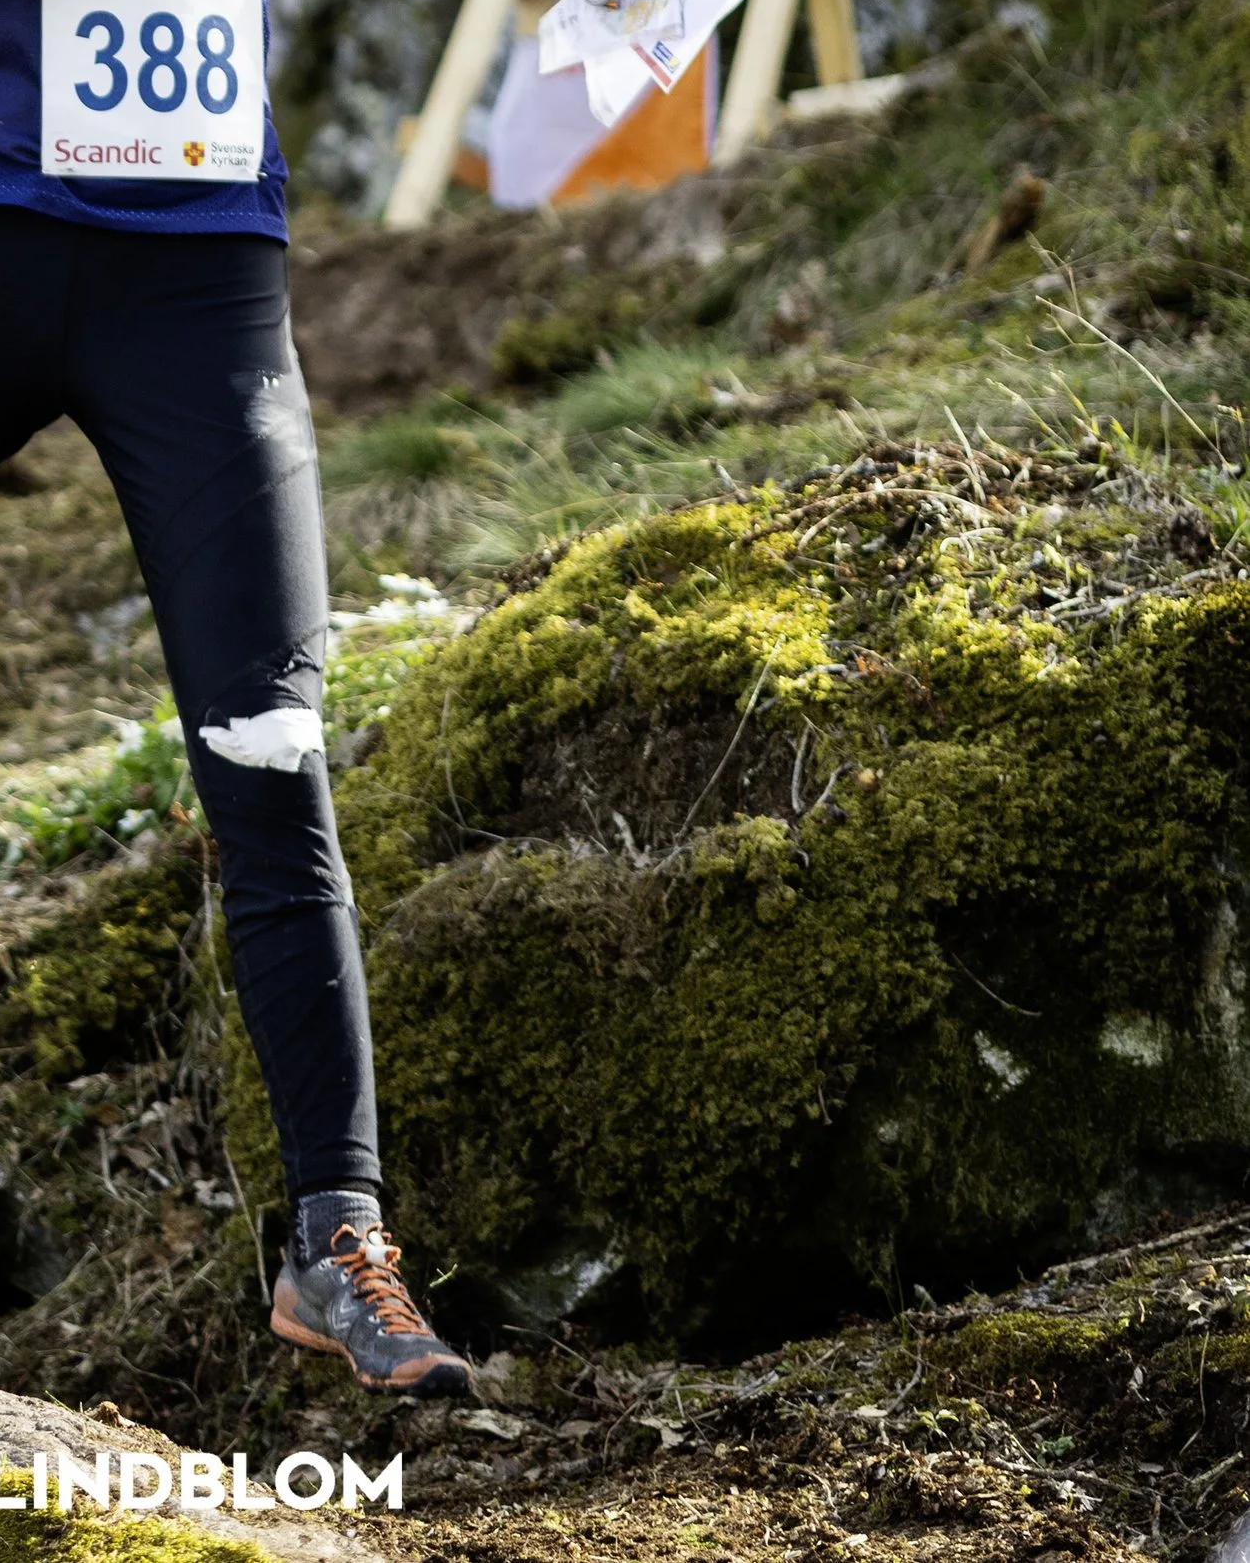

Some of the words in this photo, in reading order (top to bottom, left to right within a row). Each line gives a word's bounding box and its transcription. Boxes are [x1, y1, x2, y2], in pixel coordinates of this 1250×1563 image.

[74, 10, 238, 114] 388
[54, 139, 162, 165] Scandic
[211, 141, 255, 155] Svenska
[211, 153, 248, 168] kyrkan
